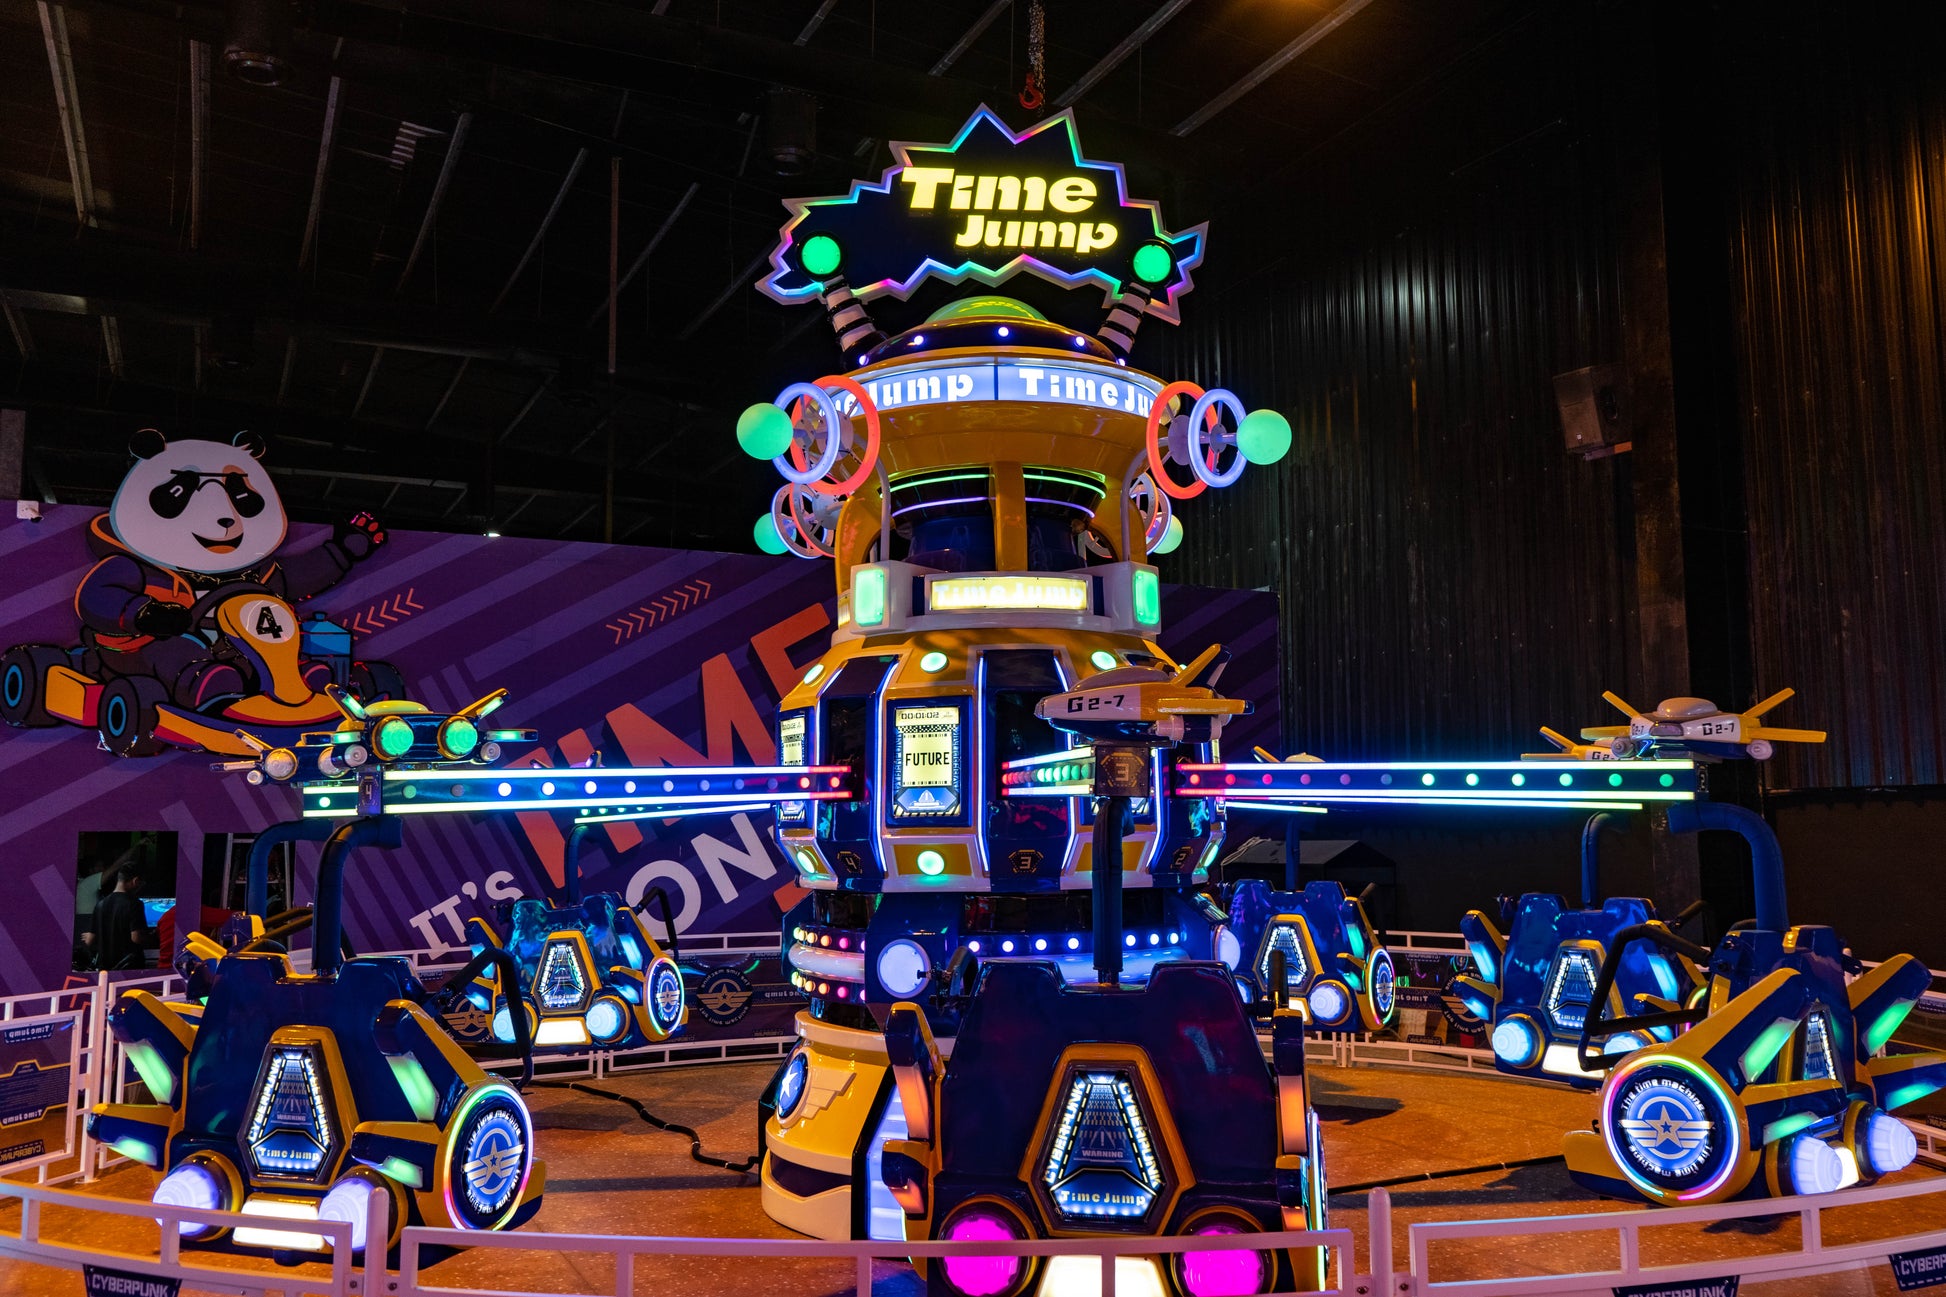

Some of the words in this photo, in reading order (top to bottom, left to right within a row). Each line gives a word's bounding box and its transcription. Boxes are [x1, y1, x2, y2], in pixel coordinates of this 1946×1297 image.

[902, 167, 1097, 213] Time
[955, 215, 1118, 253] Jump
[868, 374, 974, 407] Jump
[1019, 368, 1119, 407] Time
[1125, 385, 1154, 418] Ju
[256, 606, 283, 639] 4
[905, 752, 950, 767] FUTURE
[1116, 763, 1130, 782] 3
[1020, 856, 1032, 869] 3
[289, 1149, 320, 1161] Jump
[1082, 1149, 1124, 1158] WARNING
[1061, 1190, 1100, 1203] Time
[1103, 1192, 1146, 1206] Jump
[1901, 1254, 1946, 1275] CYBERP
[92, 1273, 169, 1297] CYBERPUNK
